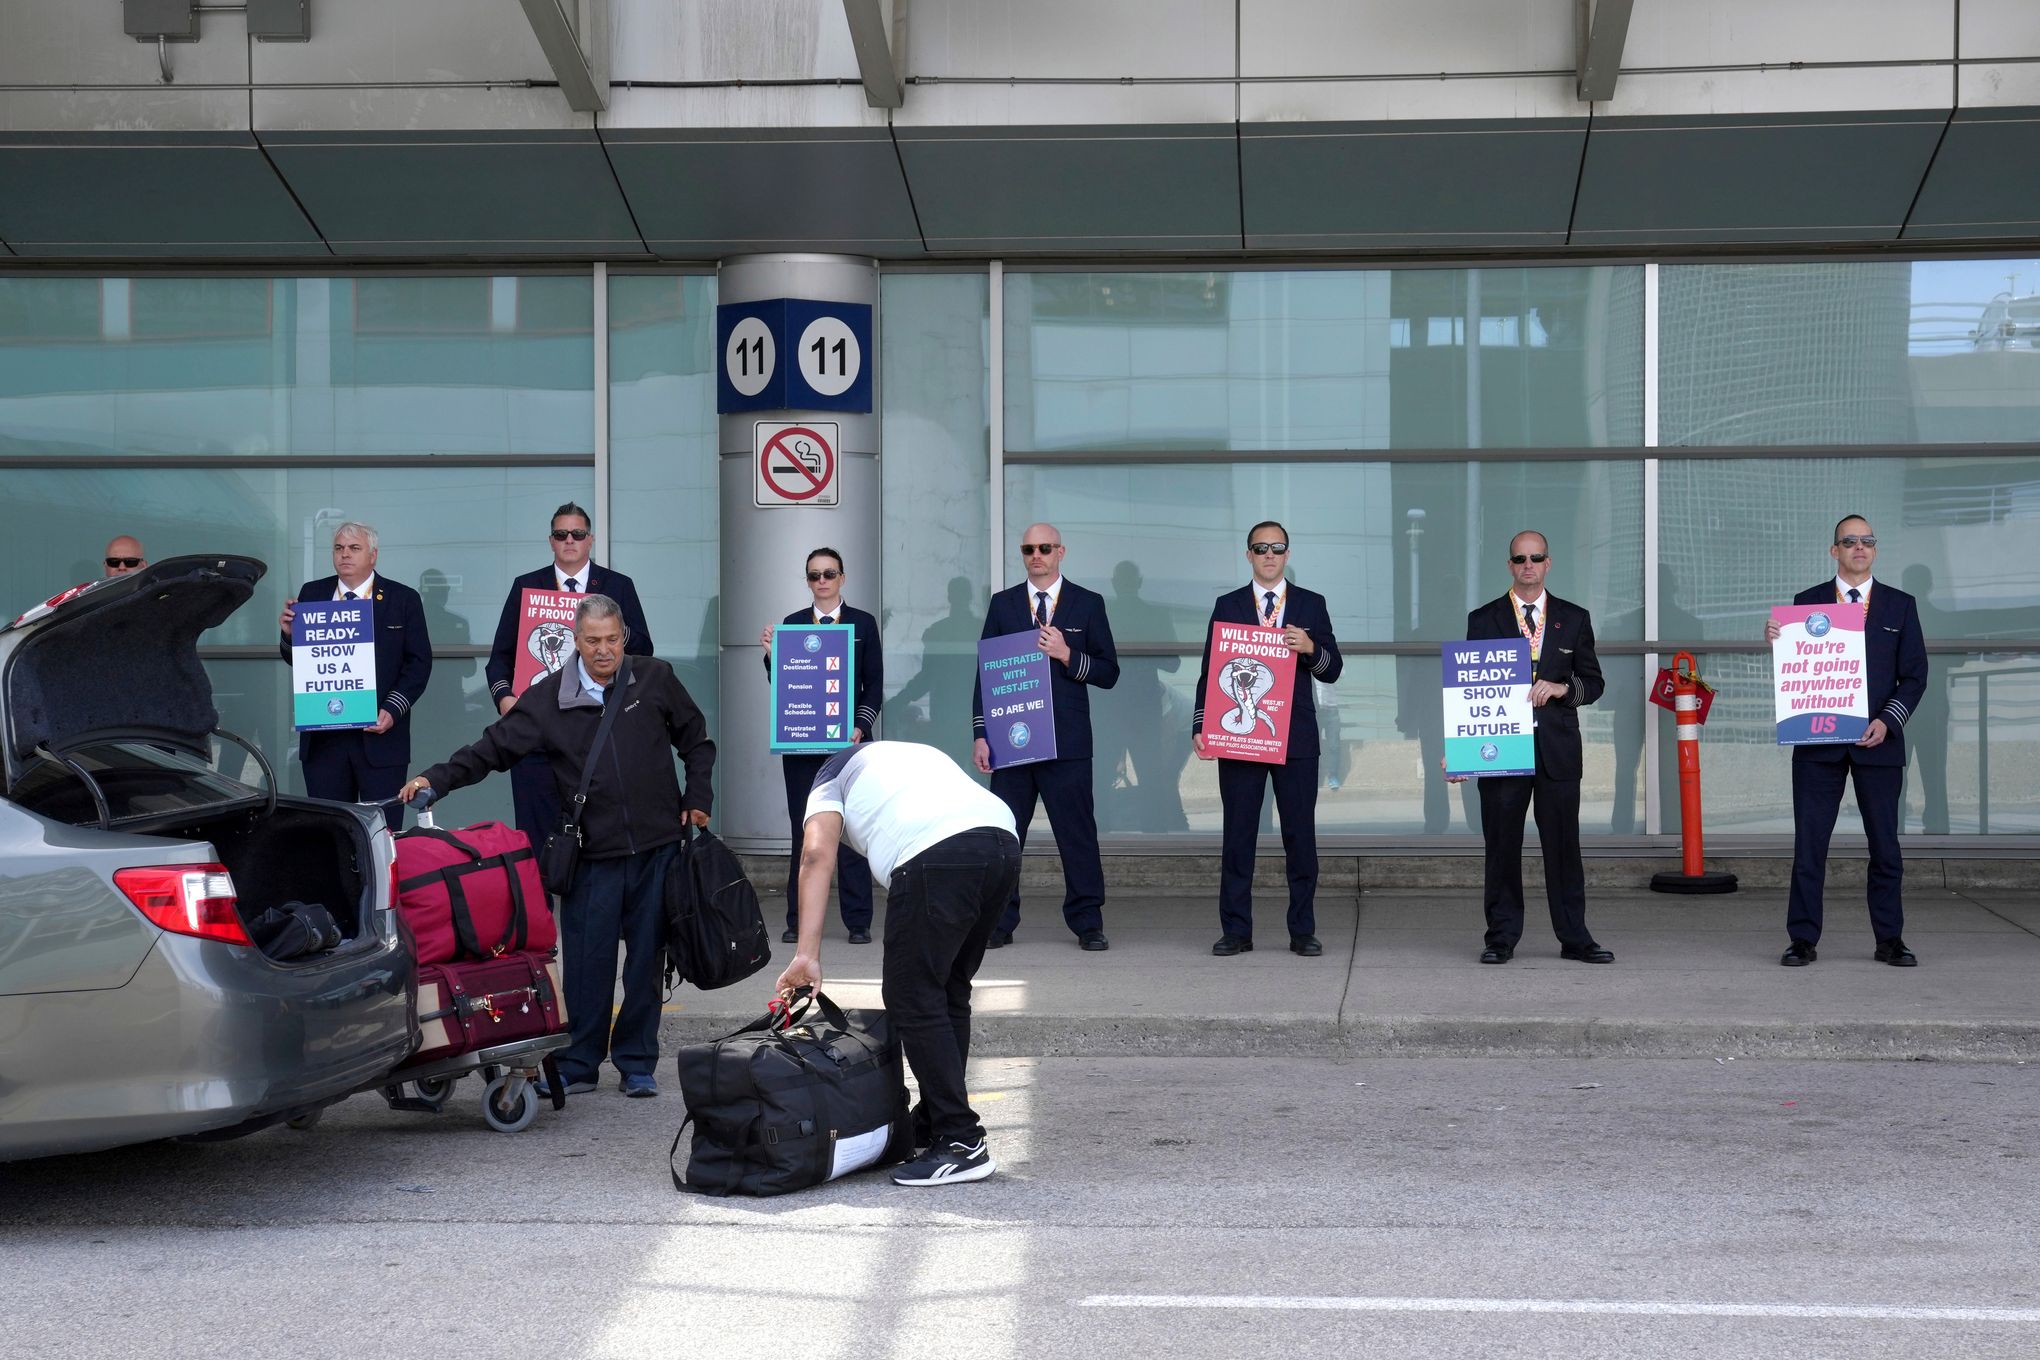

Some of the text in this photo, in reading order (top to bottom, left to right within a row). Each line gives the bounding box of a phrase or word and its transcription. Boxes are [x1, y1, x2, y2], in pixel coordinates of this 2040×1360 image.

[736, 336, 764, 376] 11
[811, 336, 846, 376] 11
[529, 594, 582, 609] WILL STR
[302, 610, 361, 625] WE ARE
[528, 607, 575, 621] IF PROVO
[305, 627, 360, 641] READY-
[1221, 627, 1287, 645] WILL STRIK
[311, 645, 356, 658] SHOW
[1219, 642, 1290, 659] IF PROVOKED
[1795, 641, 1846, 655] You're
[984, 652, 1044, 671] FRUSTRATED
[1454, 650, 1518, 665] WE ARE
[317, 662, 352, 675] US A
[1002, 668, 1027, 680] WITH
[1781, 658, 1860, 676] not going
[1457, 668, 1516, 682] READY-
[305, 679, 364, 692] FUTURE
[991, 679, 1040, 696] WESTJET?
[1780, 676, 1863, 694] anywhere
[1463, 686, 1511, 700] SHOW
[991, 699, 1044, 718] SO ARE WE!
[1791, 693, 1855, 709] without
[1470, 705, 1507, 718] US A
[1457, 723, 1520, 736] FUTURE
[1810, 715, 1837, 734] US
